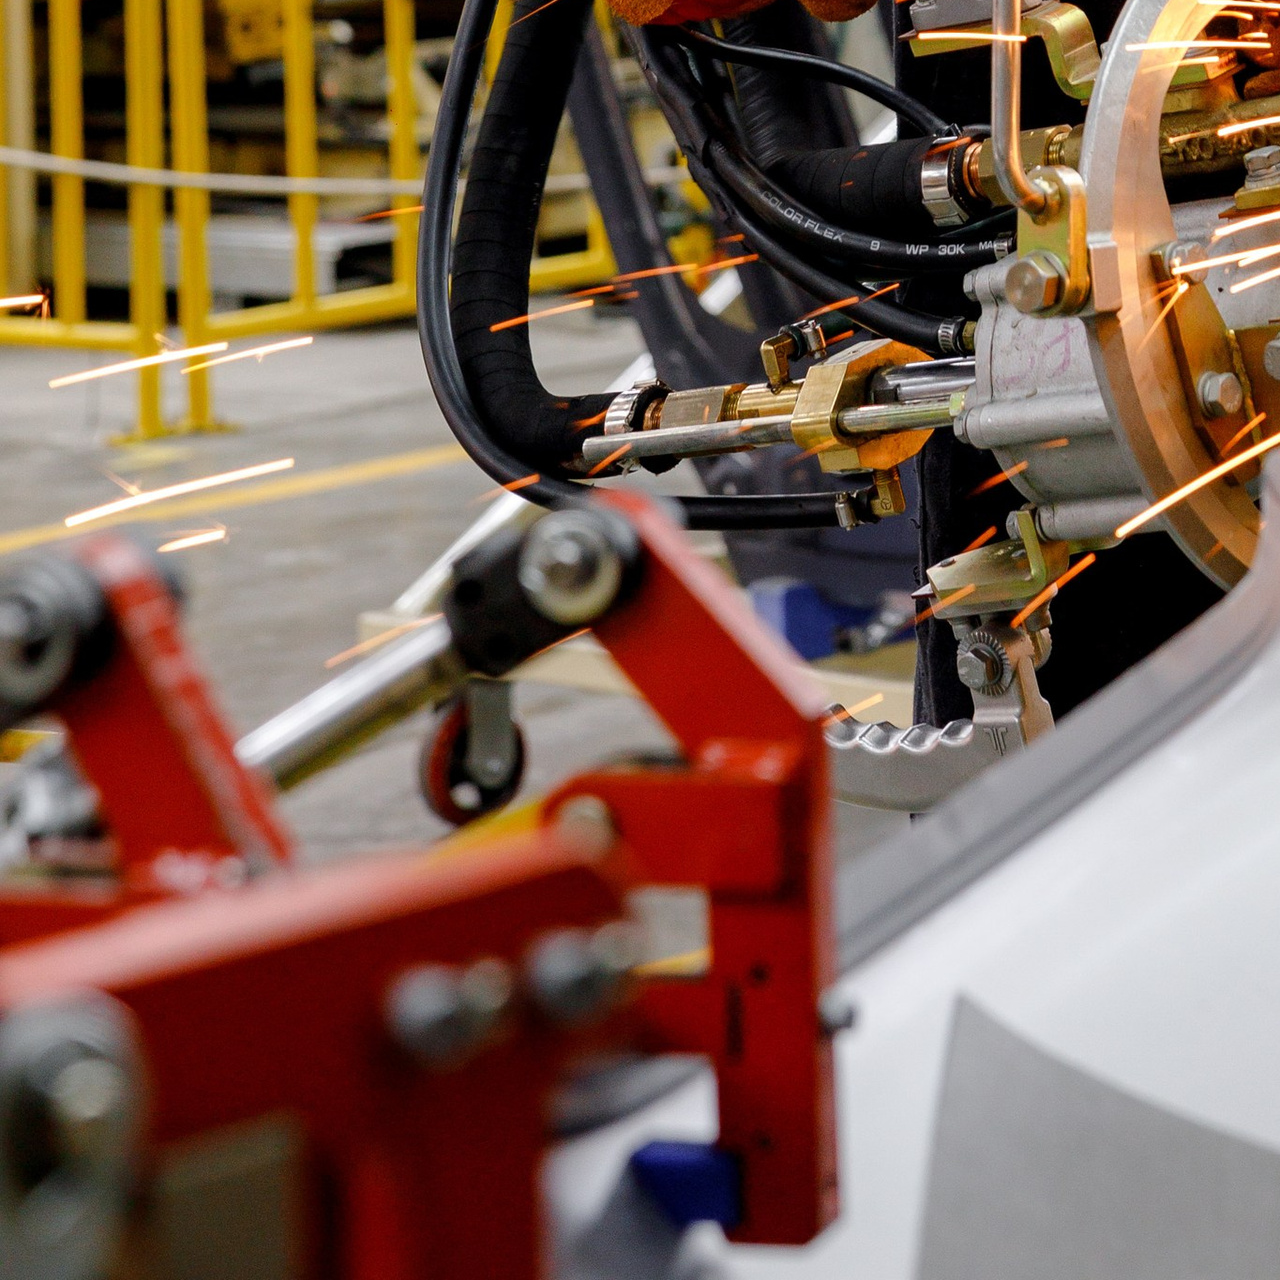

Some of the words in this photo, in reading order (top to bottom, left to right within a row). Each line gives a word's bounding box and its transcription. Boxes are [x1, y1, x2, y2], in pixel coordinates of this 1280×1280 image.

[760, 189, 802, 226] COLOR
[804, 218, 844, 244] FLEX
[869, 240, 881, 251] 9
[905, 244, 930, 256] WP
[938, 243, 966, 256] 30K
